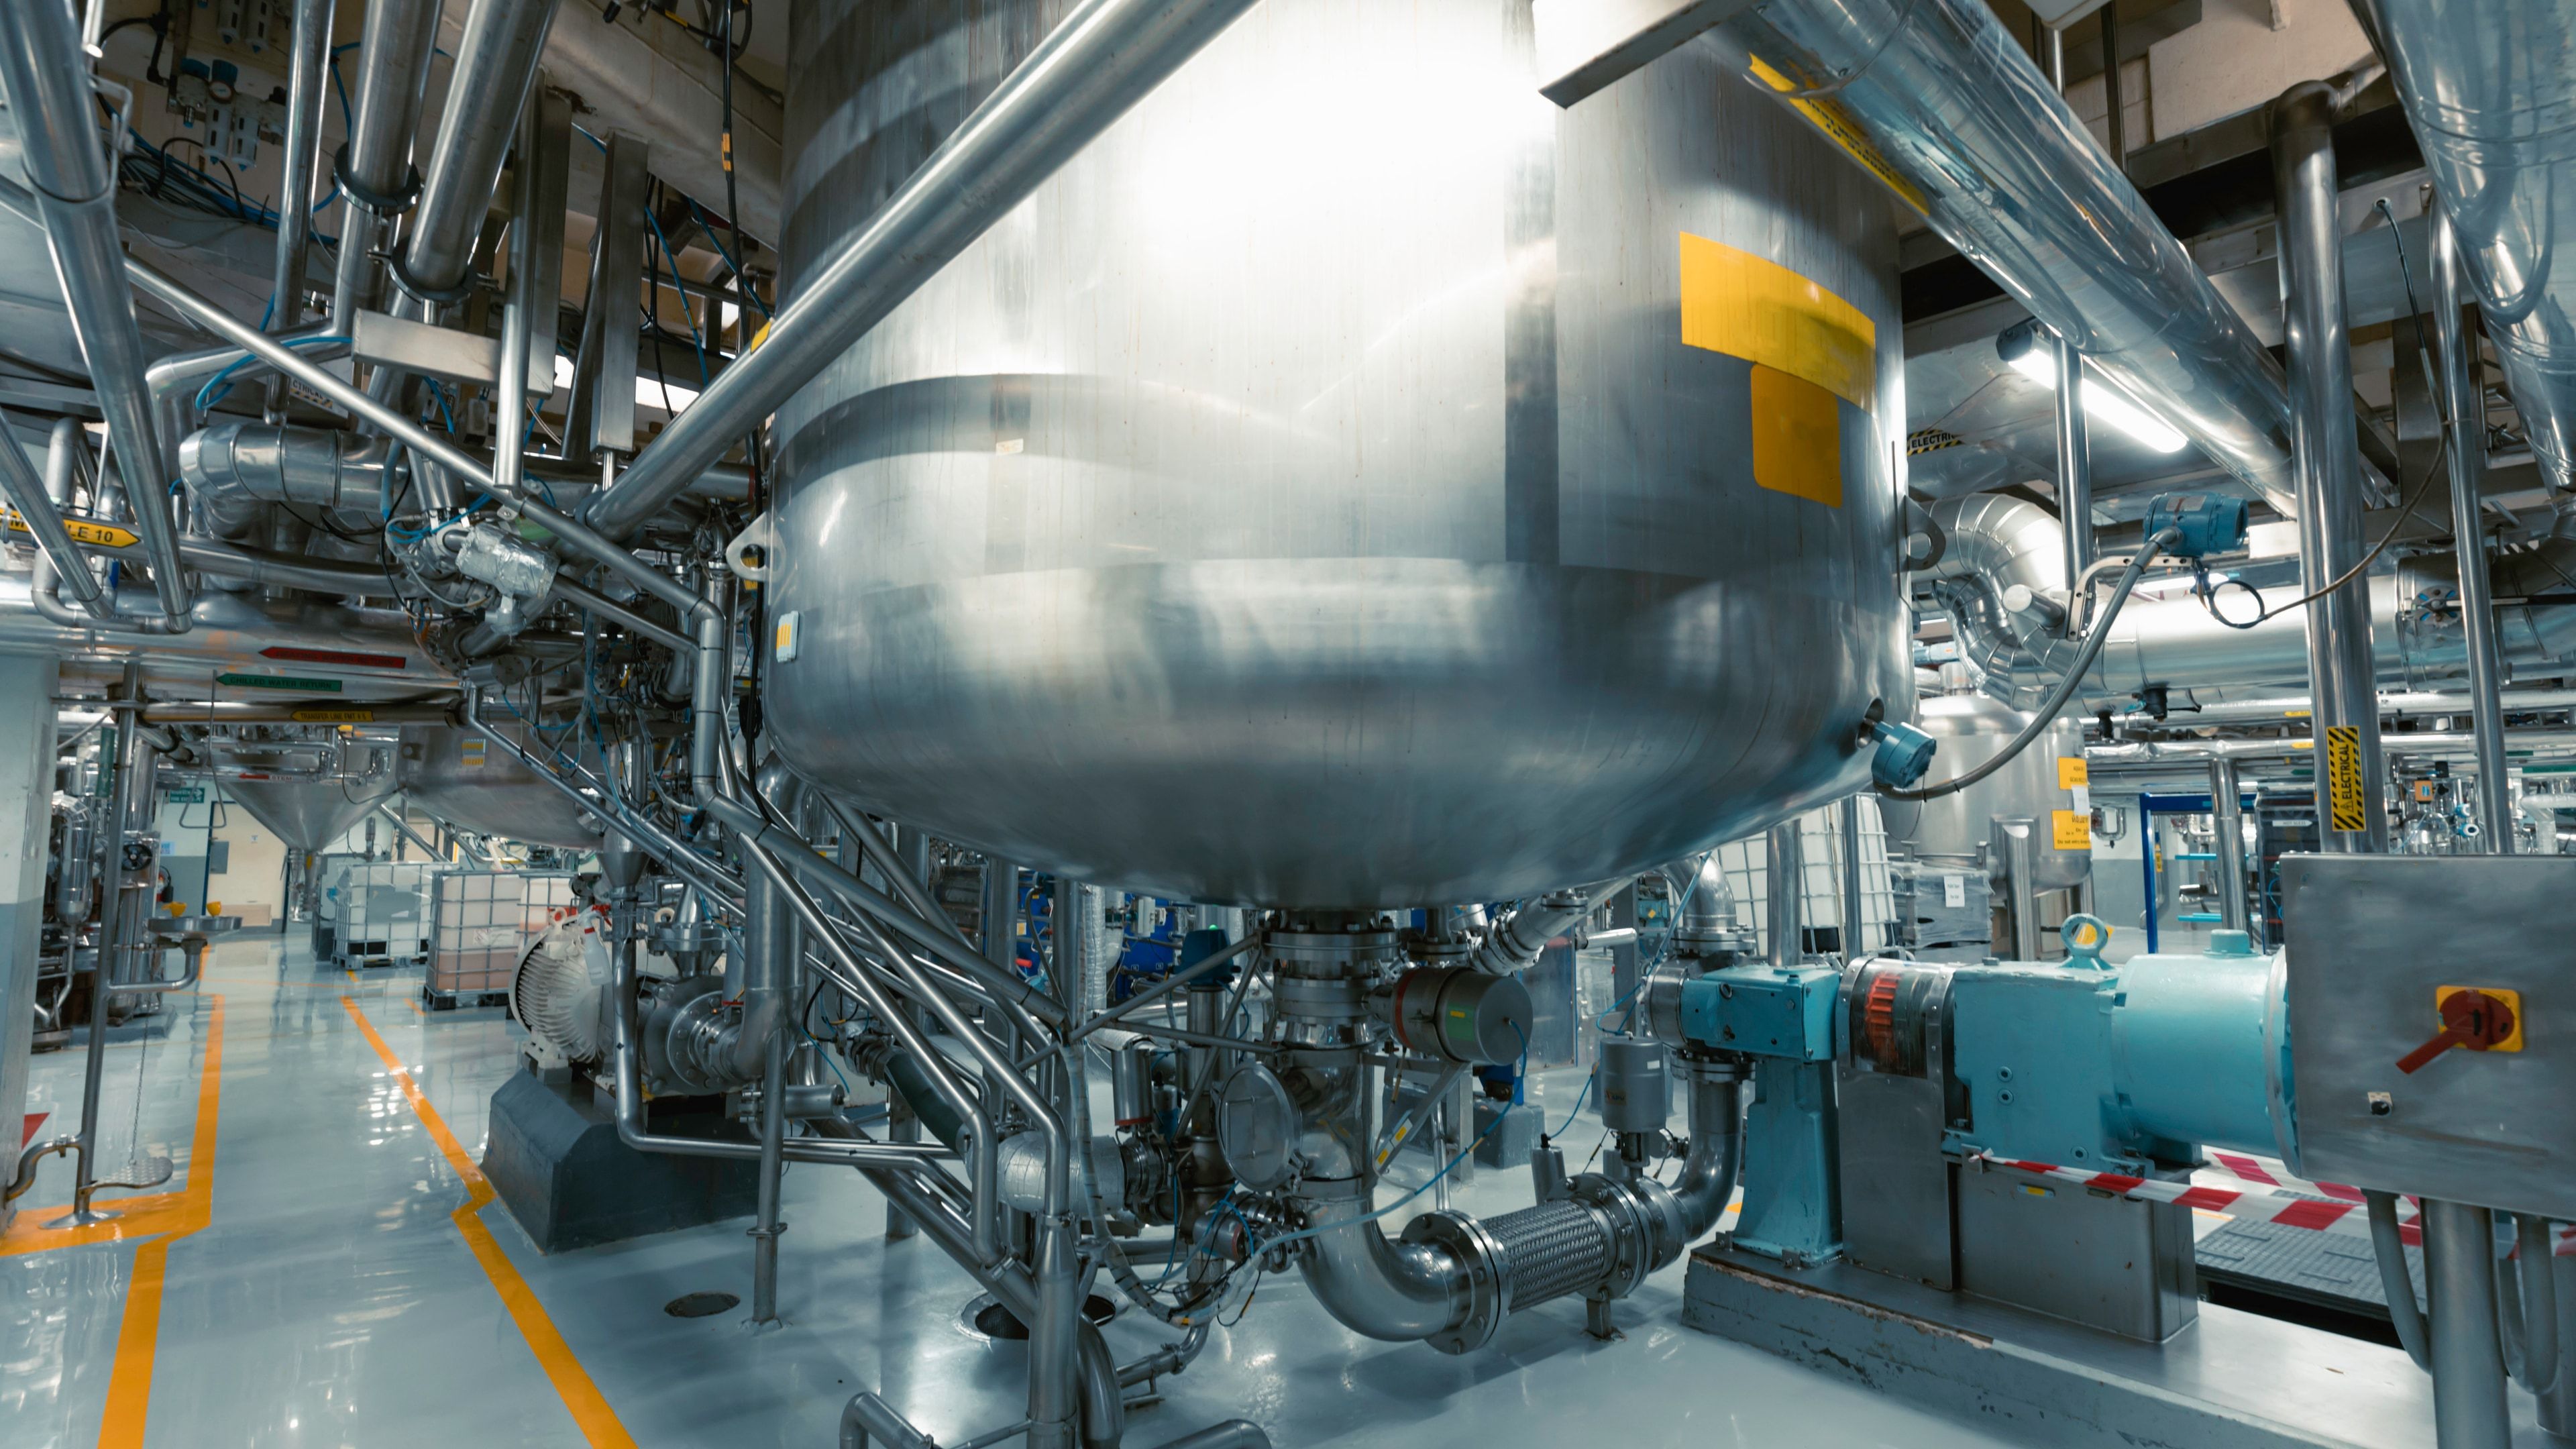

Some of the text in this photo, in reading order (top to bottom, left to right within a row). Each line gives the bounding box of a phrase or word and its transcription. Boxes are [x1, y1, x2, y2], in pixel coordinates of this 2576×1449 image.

[1912, 433, 1955, 448] ELECTRI
[96, 530, 113, 542] 10
[230, 676, 332, 690] CHILLED WATER RETURN
[2339, 744, 2353, 800] ELECTRICAL
